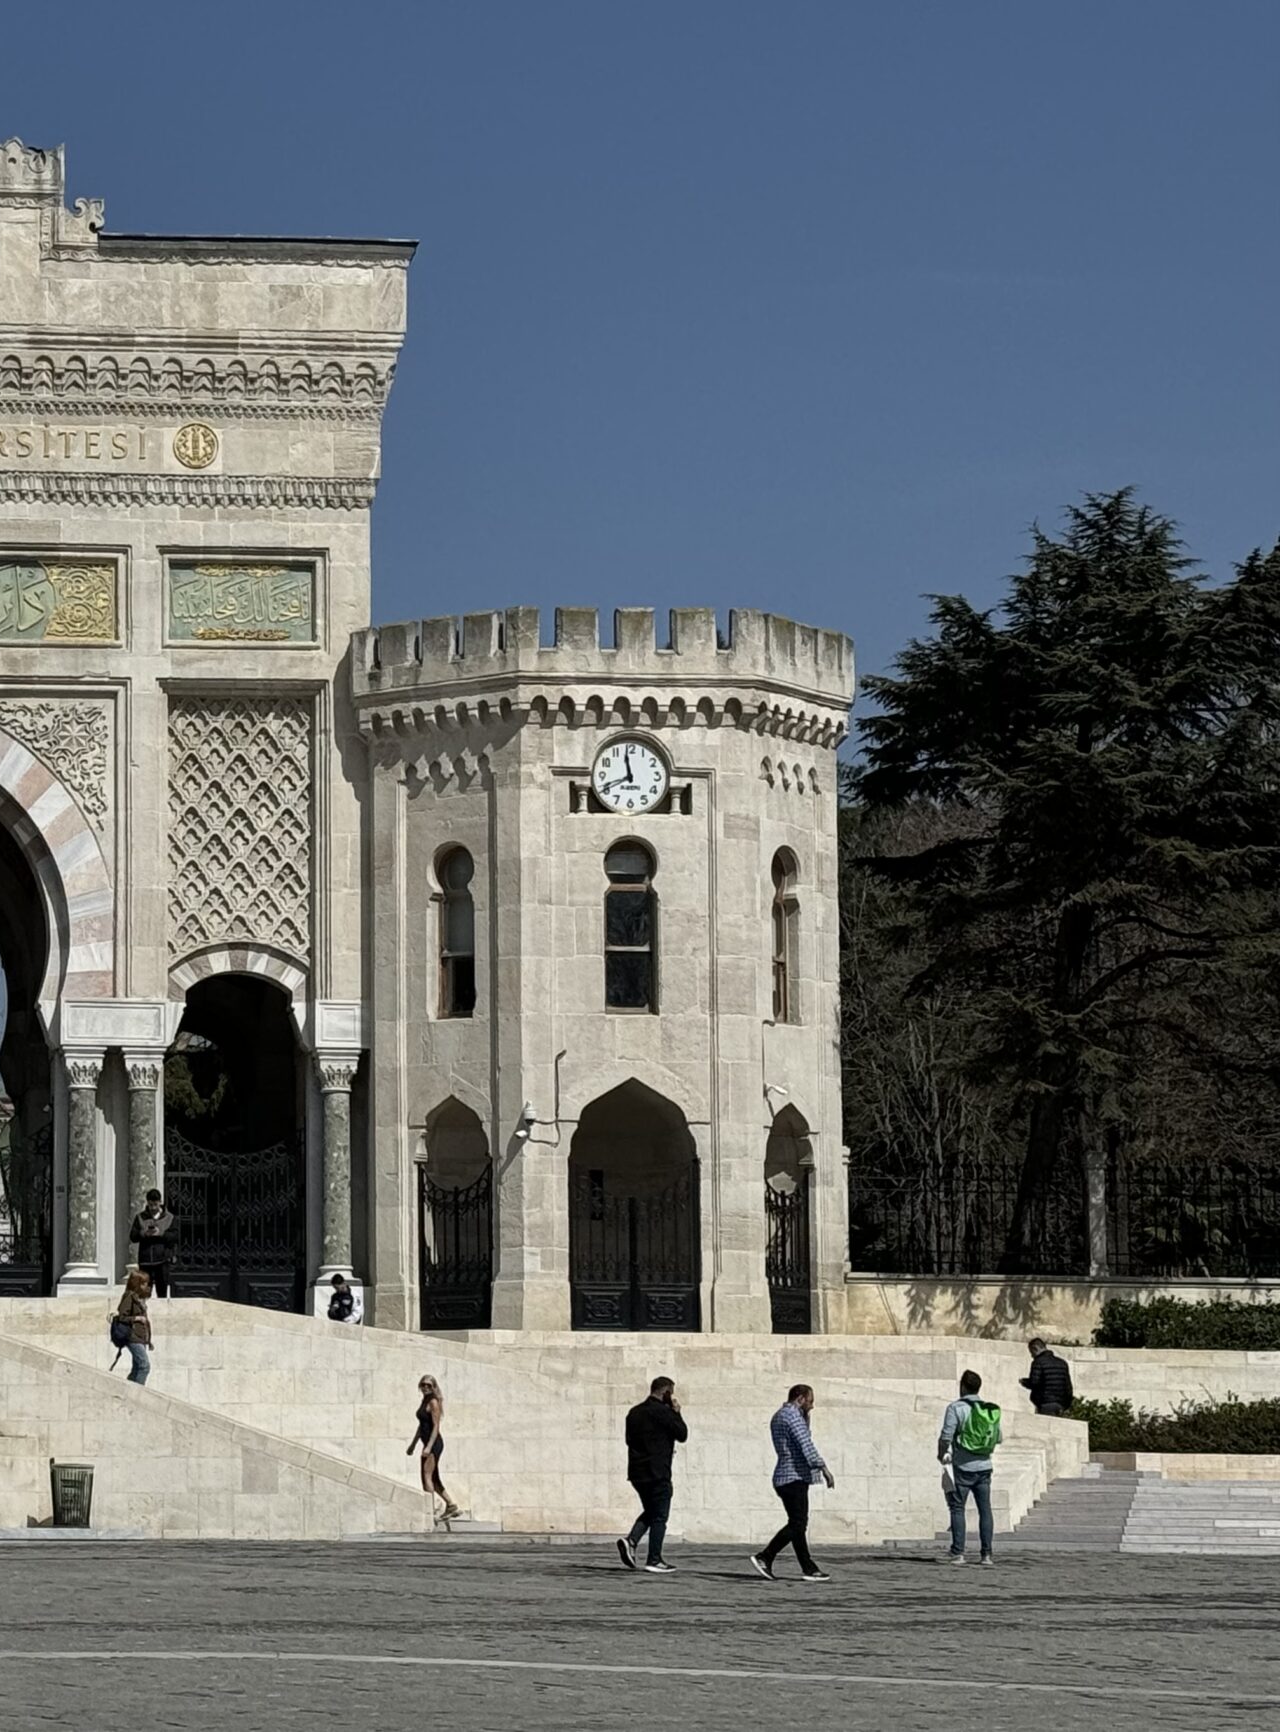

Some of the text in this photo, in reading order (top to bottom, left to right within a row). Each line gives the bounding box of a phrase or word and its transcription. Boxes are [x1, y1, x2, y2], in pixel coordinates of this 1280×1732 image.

[612, 747, 619, 758] 11
[602, 757, 611, 768] 10
[649, 757, 657, 768] 2
[598, 771, 606, 781] 9
[653, 771, 662, 782] 3
[649, 785, 657, 795] 4
[612, 795, 620, 805] 7
[626, 798, 634, 808] 6
[640, 794, 648, 805] 5
